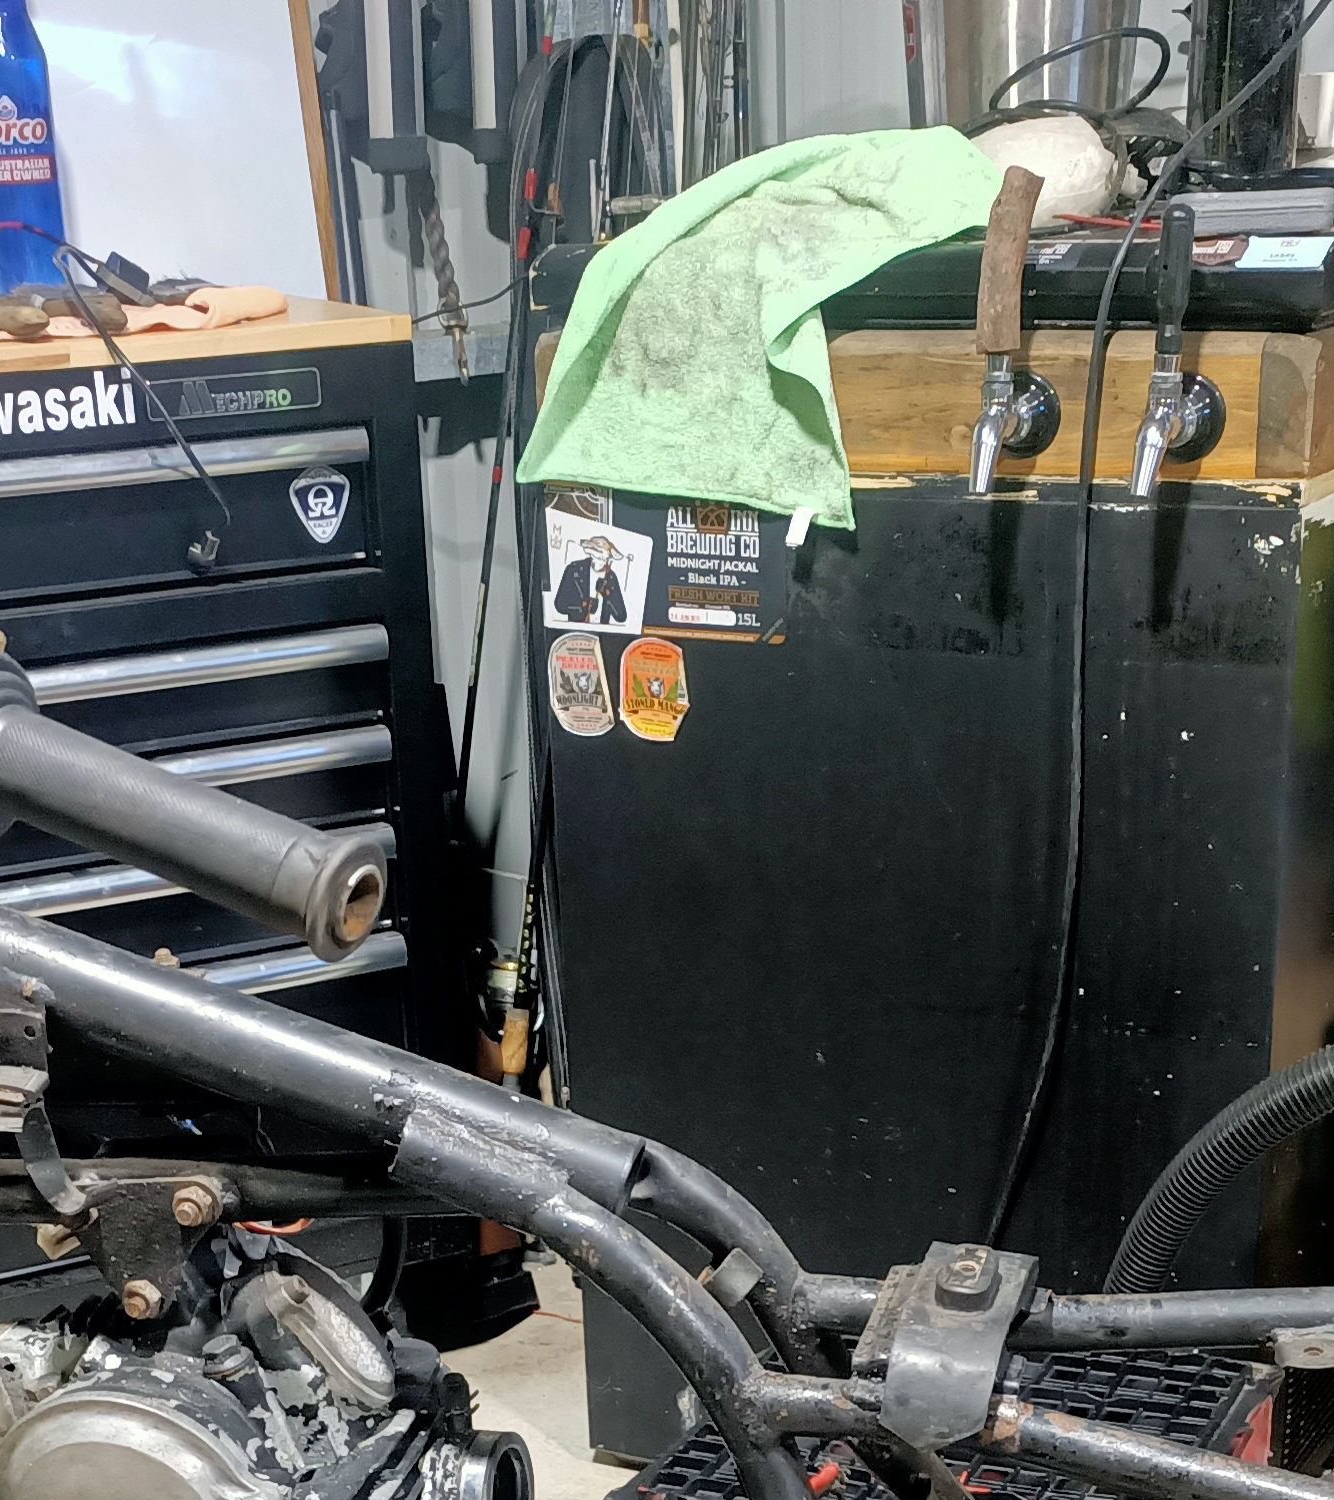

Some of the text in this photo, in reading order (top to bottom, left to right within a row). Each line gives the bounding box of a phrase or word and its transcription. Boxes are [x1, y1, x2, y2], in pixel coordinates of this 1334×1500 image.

[178, 380, 292, 415] MECHPRO
[666, 506, 759, 532] ALL INN
[666, 532, 759, 558] BREWING CO
[667, 556, 759, 573] MIDNIGHT JACKAL
[688, 572, 739, 586] Black IPA
[669, 587, 703, 600] FRESH
[705, 589, 739, 601] WORT
[737, 613, 761, 627] 15L
